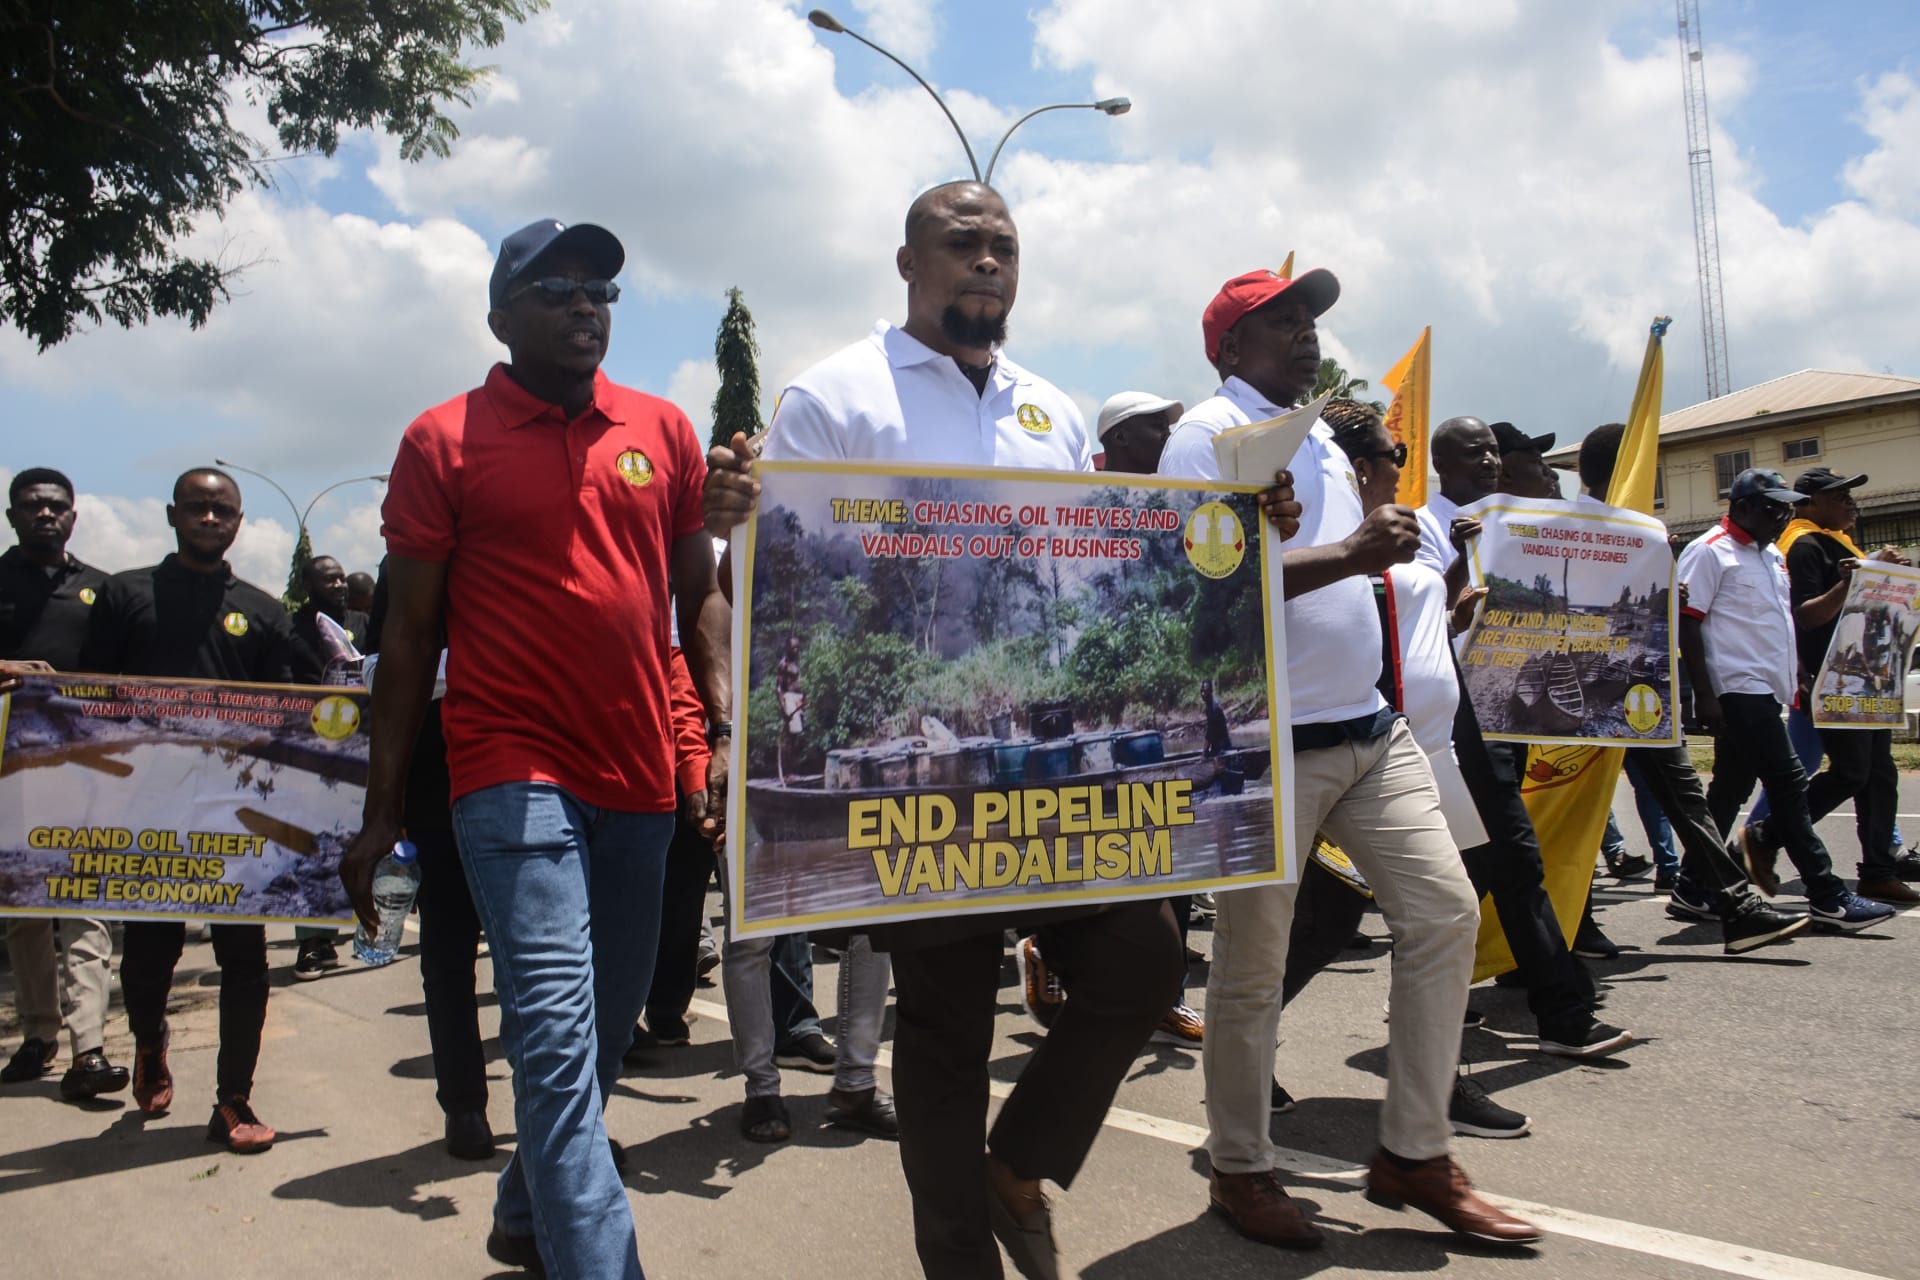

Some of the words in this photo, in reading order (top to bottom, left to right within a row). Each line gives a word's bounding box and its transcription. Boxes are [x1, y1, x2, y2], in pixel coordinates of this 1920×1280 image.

[831, 498, 908, 523] THEME:
[914, 501, 1013, 526] CHASING
[1018, 505, 1049, 527] OIL
[1055, 506, 1132, 529] THIEVES
[1135, 508, 1180, 531] AND
[860, 533, 964, 558] VANDALS
[968, 535, 1015, 558] OUT
[1018, 537, 1047, 558] OF
[1050, 537, 1142, 560] BUSINESS
[1541, 527, 1579, 542] CHASING
[1581, 531, 1593, 544] OIL
[1595, 532, 1625, 547] THIEVES
[1626, 536, 1644, 548] AND
[1521, 543, 1559, 558] VANDALS
[1561, 546, 1579, 559] OUT
[1581, 549, 1592, 560] OF
[1593, 550, 1628, 564] BUSINESS
[1484, 610, 1512, 626] OUR
[1512, 611, 1544, 630] LAND
[1545, 613, 1567, 631] AND
[1476, 631, 1501, 646] ARE
[1502, 632, 1571, 652] DESTROYED
[1571, 635, 1613, 652] BECAUSE
[1614, 637, 1630, 652] OF
[1466, 650, 1487, 666] OIL
[1489, 650, 1530, 668] THEFT
[60, 684, 113, 699] THEME:
[116, 684, 189, 701] CHASING
[191, 688, 216, 704] OIL
[218, 691, 279, 709] THIEVES
[279, 695, 315, 712] AND
[1824, 695, 1853, 712] STOP
[1858, 697, 1877, 713] THE
[81, 702, 152, 718] VANDALS
[154, 704, 188, 719] OUT
[190, 705, 214, 720] OF
[215, 708, 284, 727] BUSINESS
[848, 794, 957, 850] END
[973, 779, 1194, 839] PIPELINE
[28, 826, 133, 850] GRAND
[138, 828, 184, 854] OIL
[188, 831, 267, 858] THEFT
[69, 852, 226, 881] THREATENS
[871, 829, 1173, 898] VANDALISM
[45, 876, 100, 901] THE
[105, 879, 243, 907] ECONOMY
